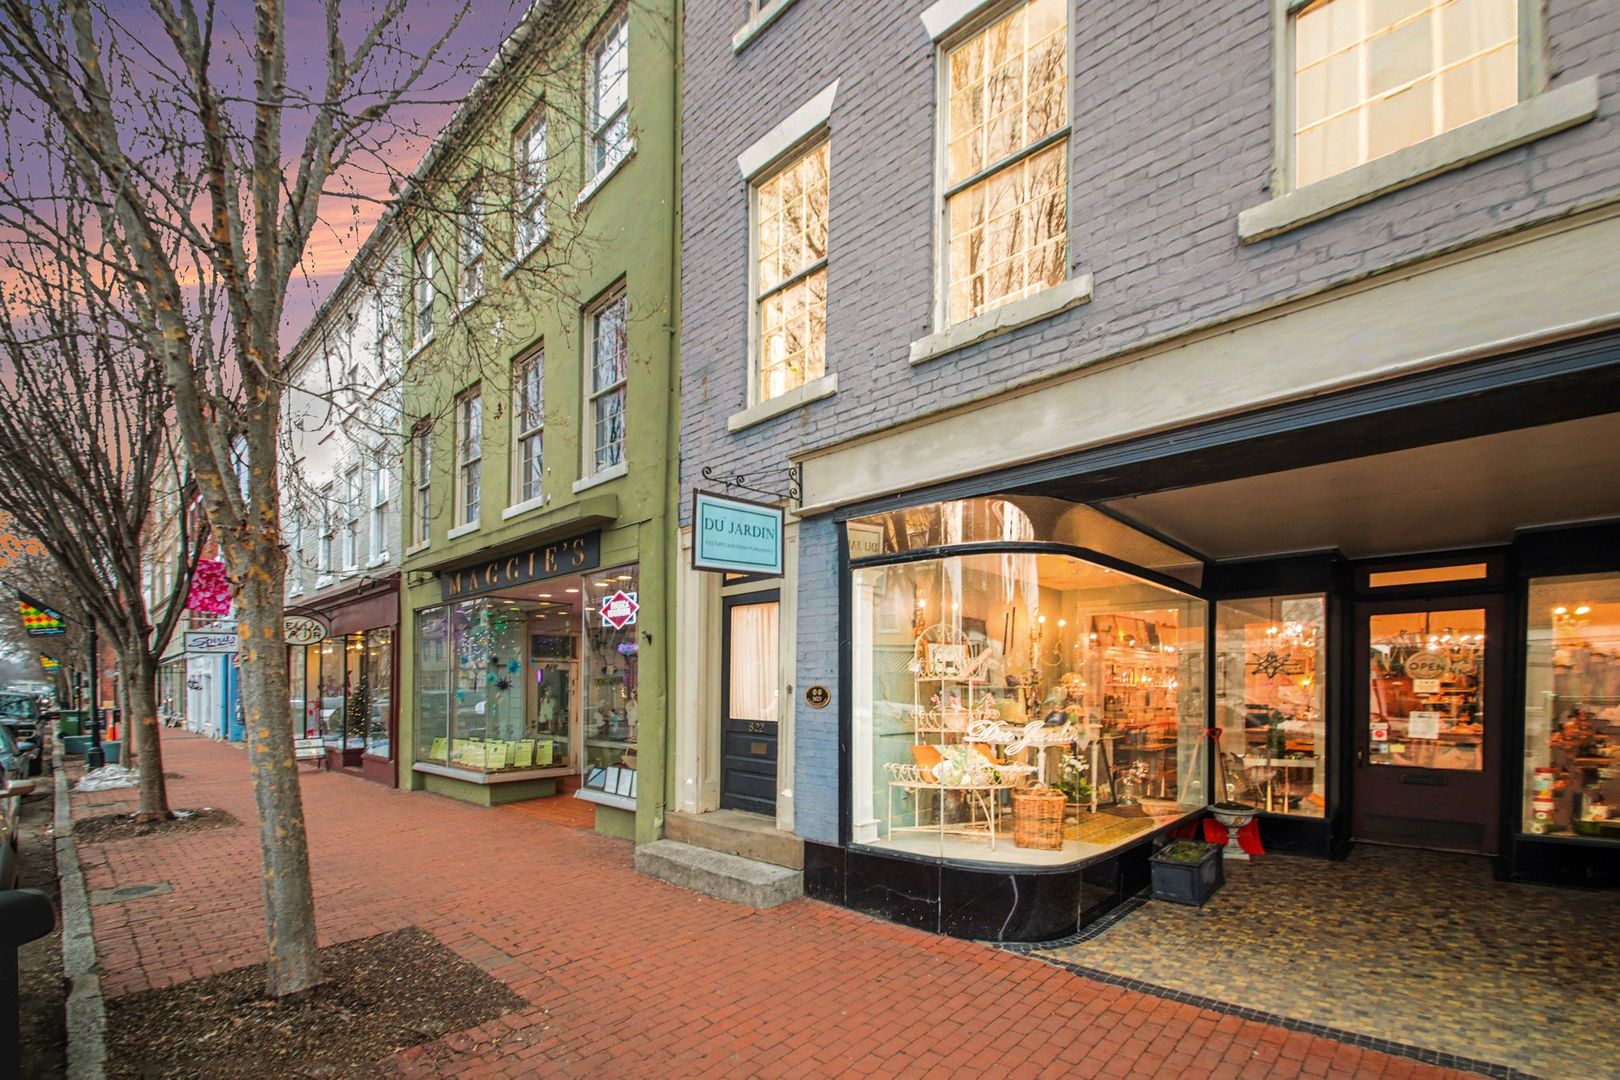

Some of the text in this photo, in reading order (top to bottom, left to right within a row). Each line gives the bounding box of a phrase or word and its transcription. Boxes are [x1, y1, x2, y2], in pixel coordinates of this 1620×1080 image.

[705, 518, 775, 540] DU JARDIN
[449, 538, 585, 595] MAGGIE'S
[1410, 662, 1445, 672] OPEN
